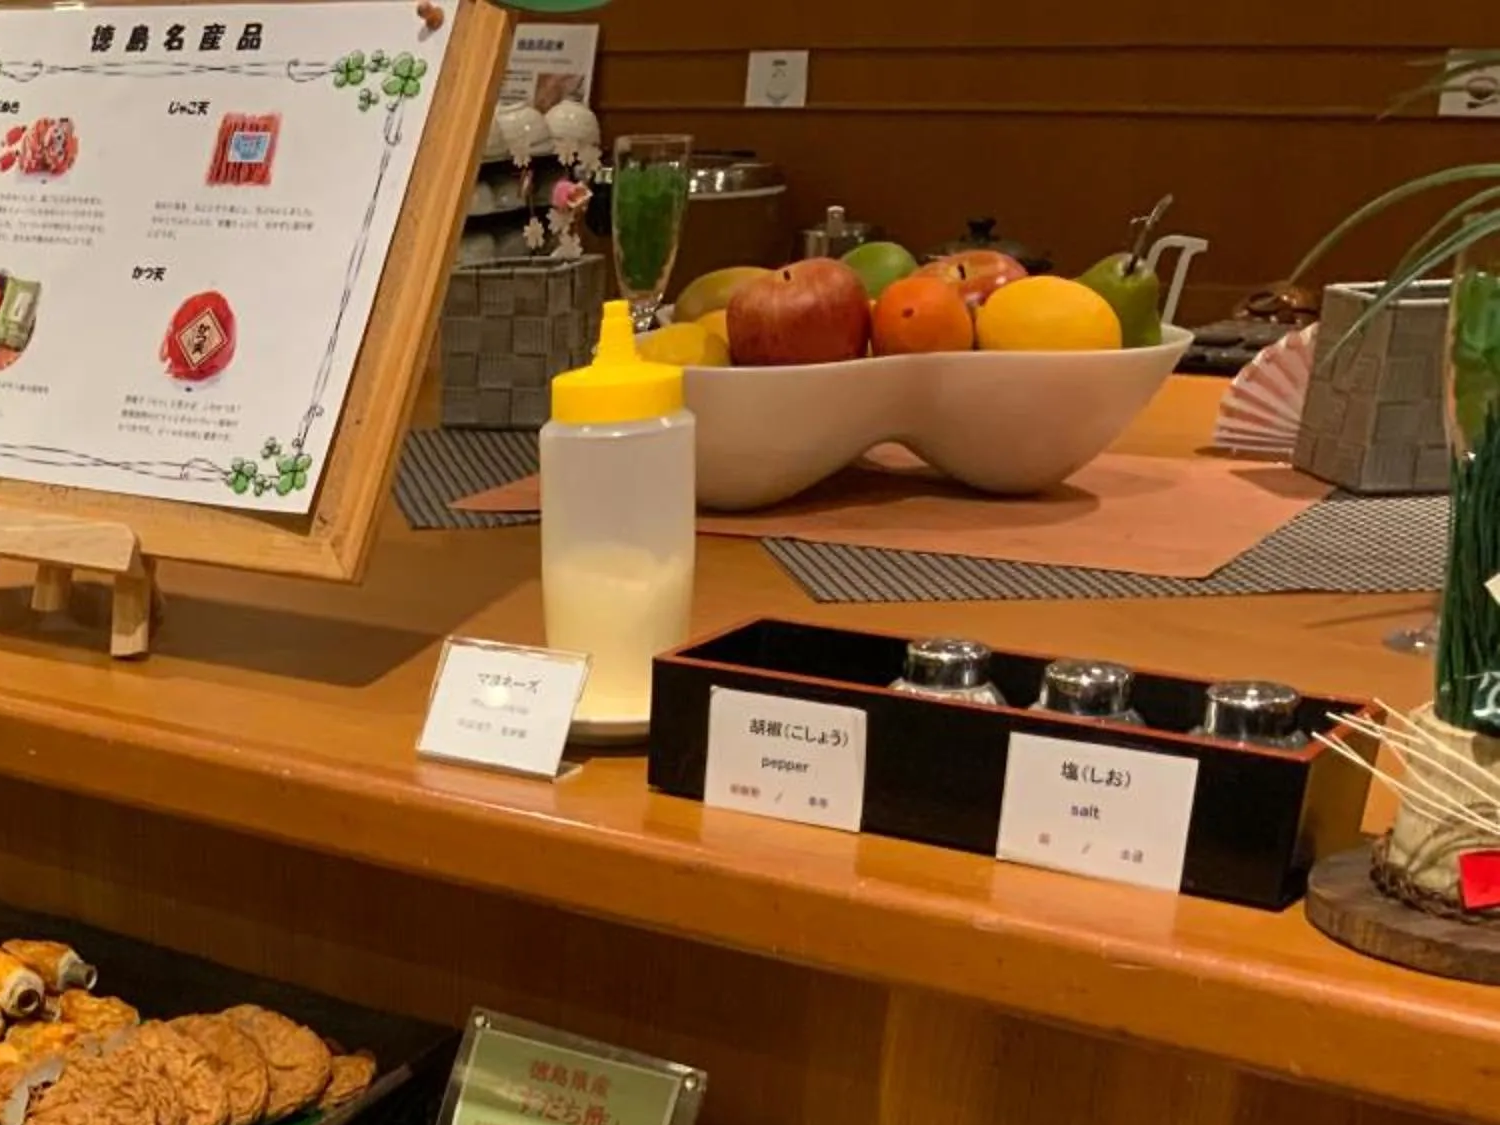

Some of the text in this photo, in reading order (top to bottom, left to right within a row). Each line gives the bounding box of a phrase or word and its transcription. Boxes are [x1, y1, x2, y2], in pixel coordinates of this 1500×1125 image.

[90, 22, 263, 52] 徳島名産品
[167, 101, 210, 115] じゃこ天
[131, 265, 167, 281] かつ天
[761, 756, 811, 774] pepper
[1070, 804, 1101, 820] salt
